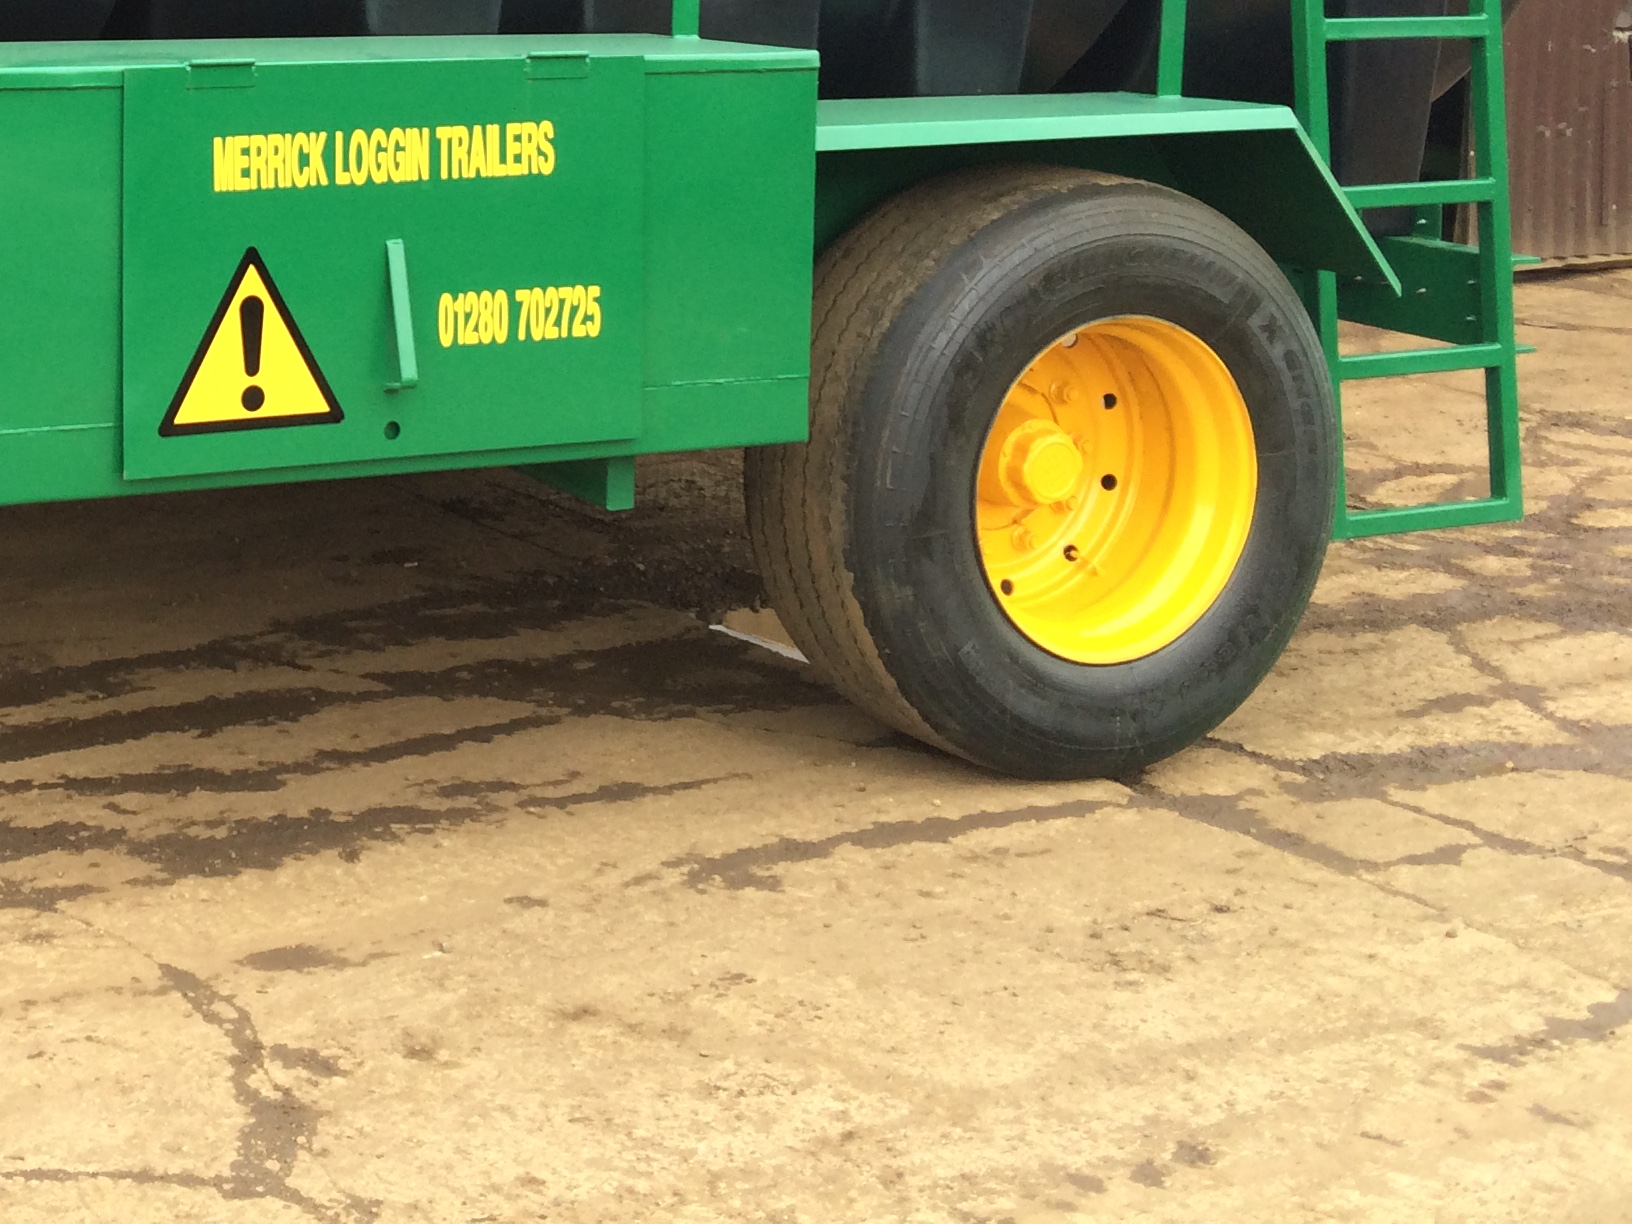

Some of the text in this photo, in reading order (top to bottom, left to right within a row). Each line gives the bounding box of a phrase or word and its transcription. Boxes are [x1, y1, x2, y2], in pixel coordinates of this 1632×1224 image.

[212, 119, 556, 192] MERRICK LOGGIN TRAILERS
[437, 284, 602, 348] 01280 702725
